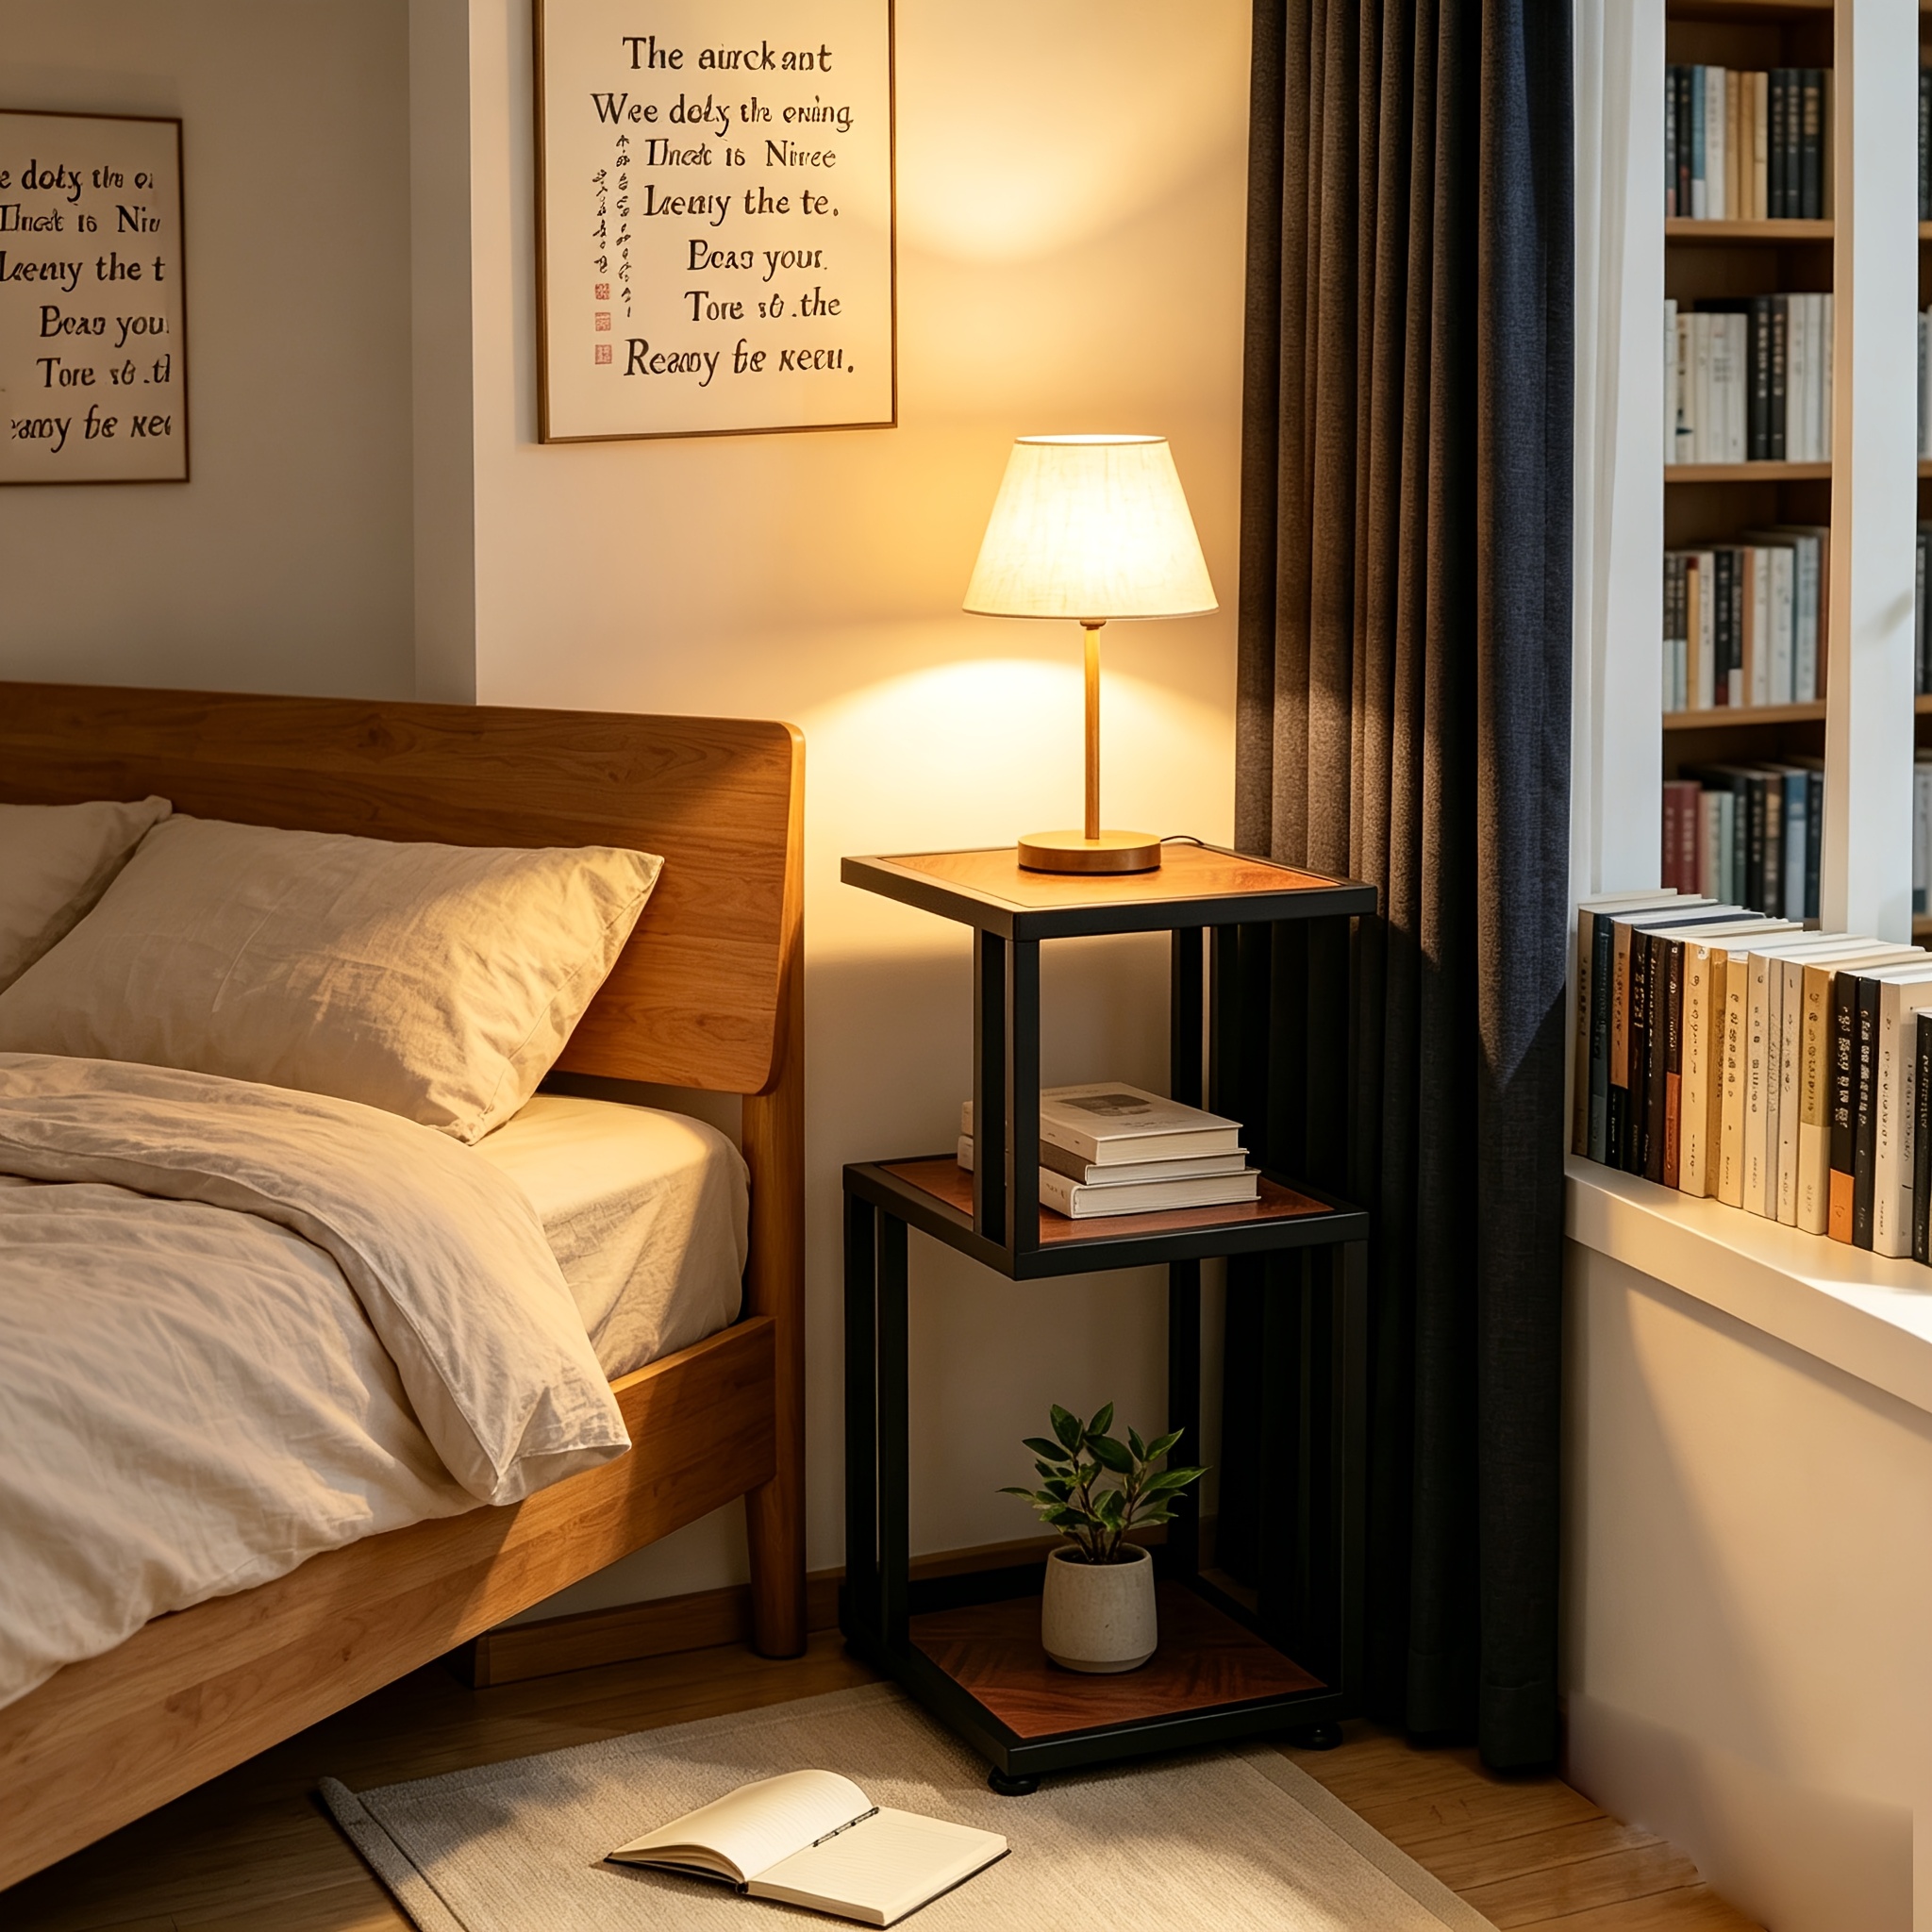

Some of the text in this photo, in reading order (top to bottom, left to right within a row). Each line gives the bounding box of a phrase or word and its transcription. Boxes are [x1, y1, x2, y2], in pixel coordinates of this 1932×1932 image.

[622, 36, 684, 71] The
[590, 92, 658, 125] Wee
[743, 186, 791, 215] the
[800, 189, 840, 217] te.
[95, 251, 142, 282] the
[684, 291, 745, 322] Tore
[36, 357, 96, 388] Tore
